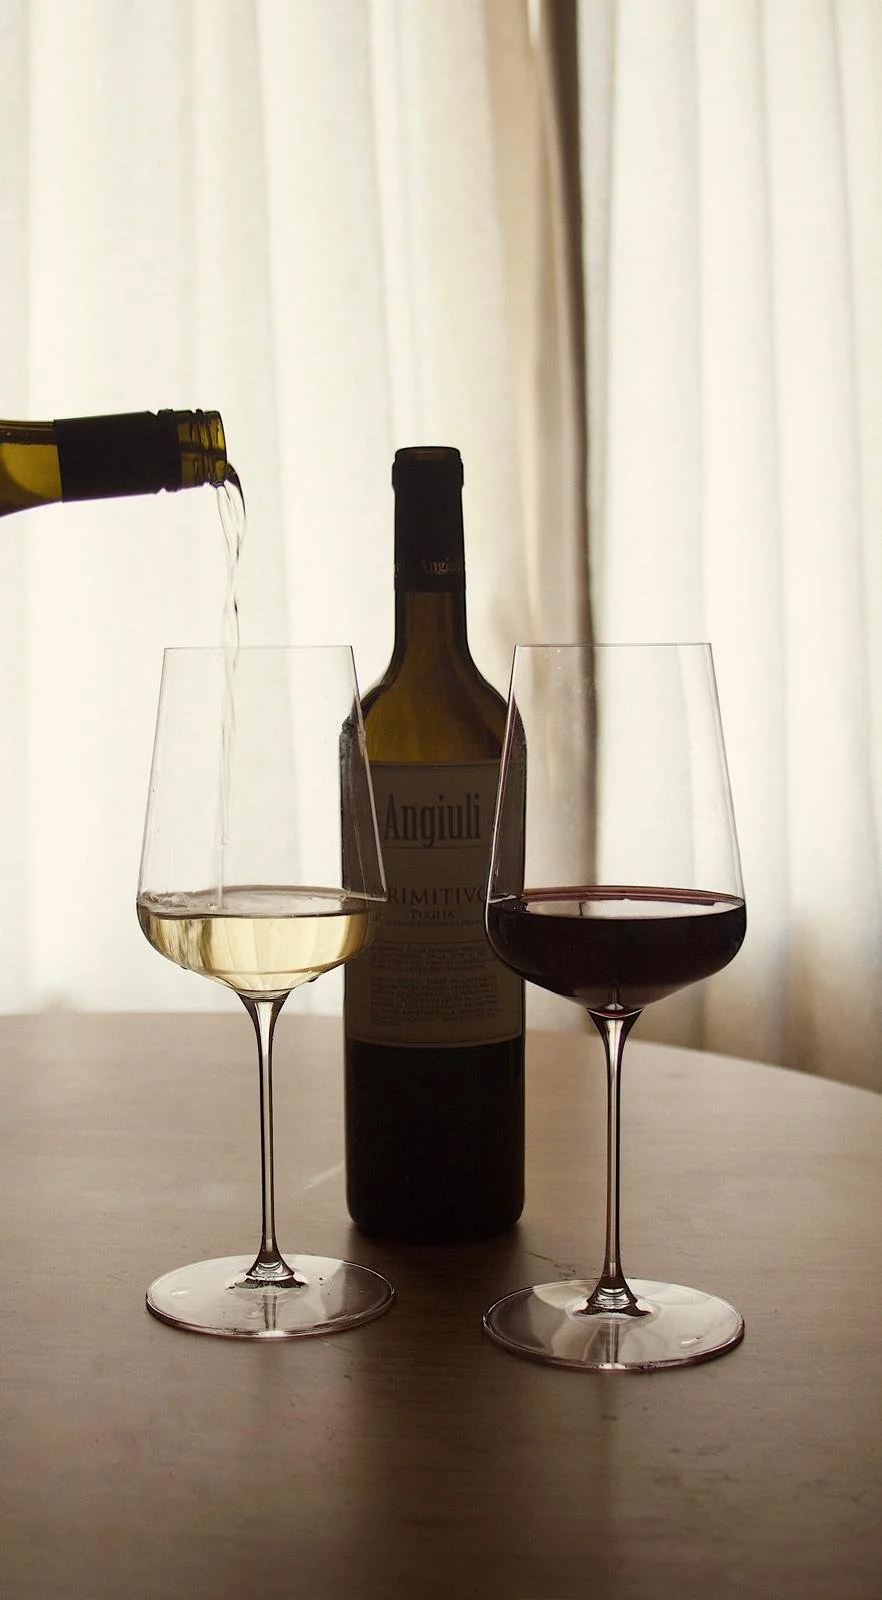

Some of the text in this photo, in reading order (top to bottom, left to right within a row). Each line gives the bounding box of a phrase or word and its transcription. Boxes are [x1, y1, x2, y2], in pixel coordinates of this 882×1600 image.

[383, 793, 481, 847] Angiuli
[387, 887, 486, 905] RIMITIVO
[411, 908, 454, 920] PUGLIA
